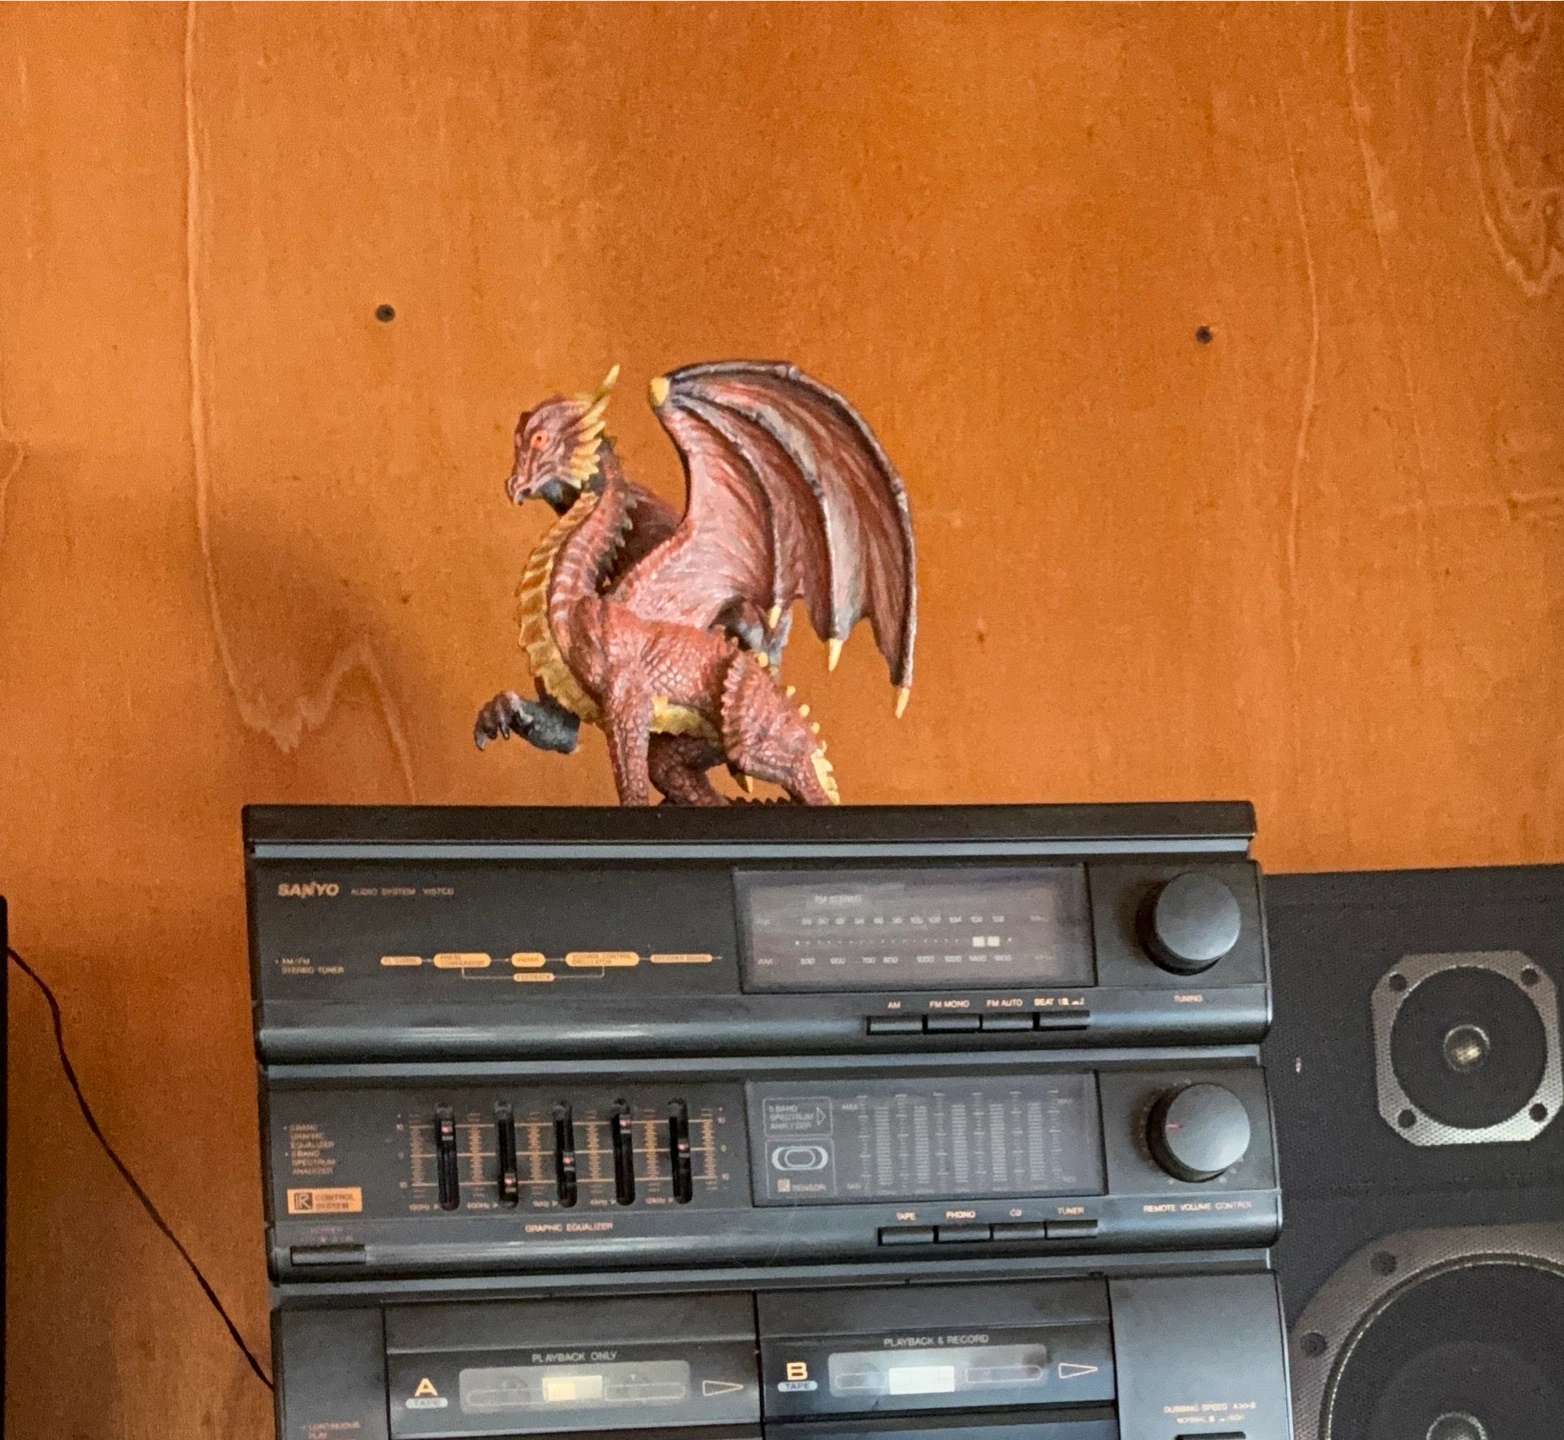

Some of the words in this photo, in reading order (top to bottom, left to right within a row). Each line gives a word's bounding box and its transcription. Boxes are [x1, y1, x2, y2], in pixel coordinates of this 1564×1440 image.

[278, 881, 340, 898] SANYO
[351, 887, 378, 896] AUDIO
[381, 887, 417, 896] SYSTEM
[887, 1001, 901, 1009] AM
[929, 1000, 942, 1009] FM
[944, 1000, 970, 1008] MONO
[986, 999, 999, 1007] FM
[1000, 999, 1023, 1007] AUTO
[1034, 998, 1054, 1007] BEAT
[1174, 994, 1203, 1003] TUNING
[775, 1105, 798, 1113] BAND
[769, 1113, 814, 1121] SPECTRUM
[1143, 1204, 1176, 1213] REMOTE
[1180, 1202, 1211, 1211] VOLUME
[1215, 1200, 1252, 1210] CONTROL
[946, 1210, 976, 1219] PHONO
[1057, 1207, 1084, 1216] TUNER
[525, 1223, 563, 1233] GRAPHIC
[566, 1221, 614, 1232] EQUALIZER
[884, 1337, 934, 1347] PLAYBACK
[946, 1334, 989, 1345] RECORD
[532, 1352, 586, 1363] PLAYBACK
[591, 1351, 617, 1361] ONLY
[786, 1362, 808, 1381] B
[414, 1377, 438, 1397] A
[784, 1382, 811, 1391] TAPE
